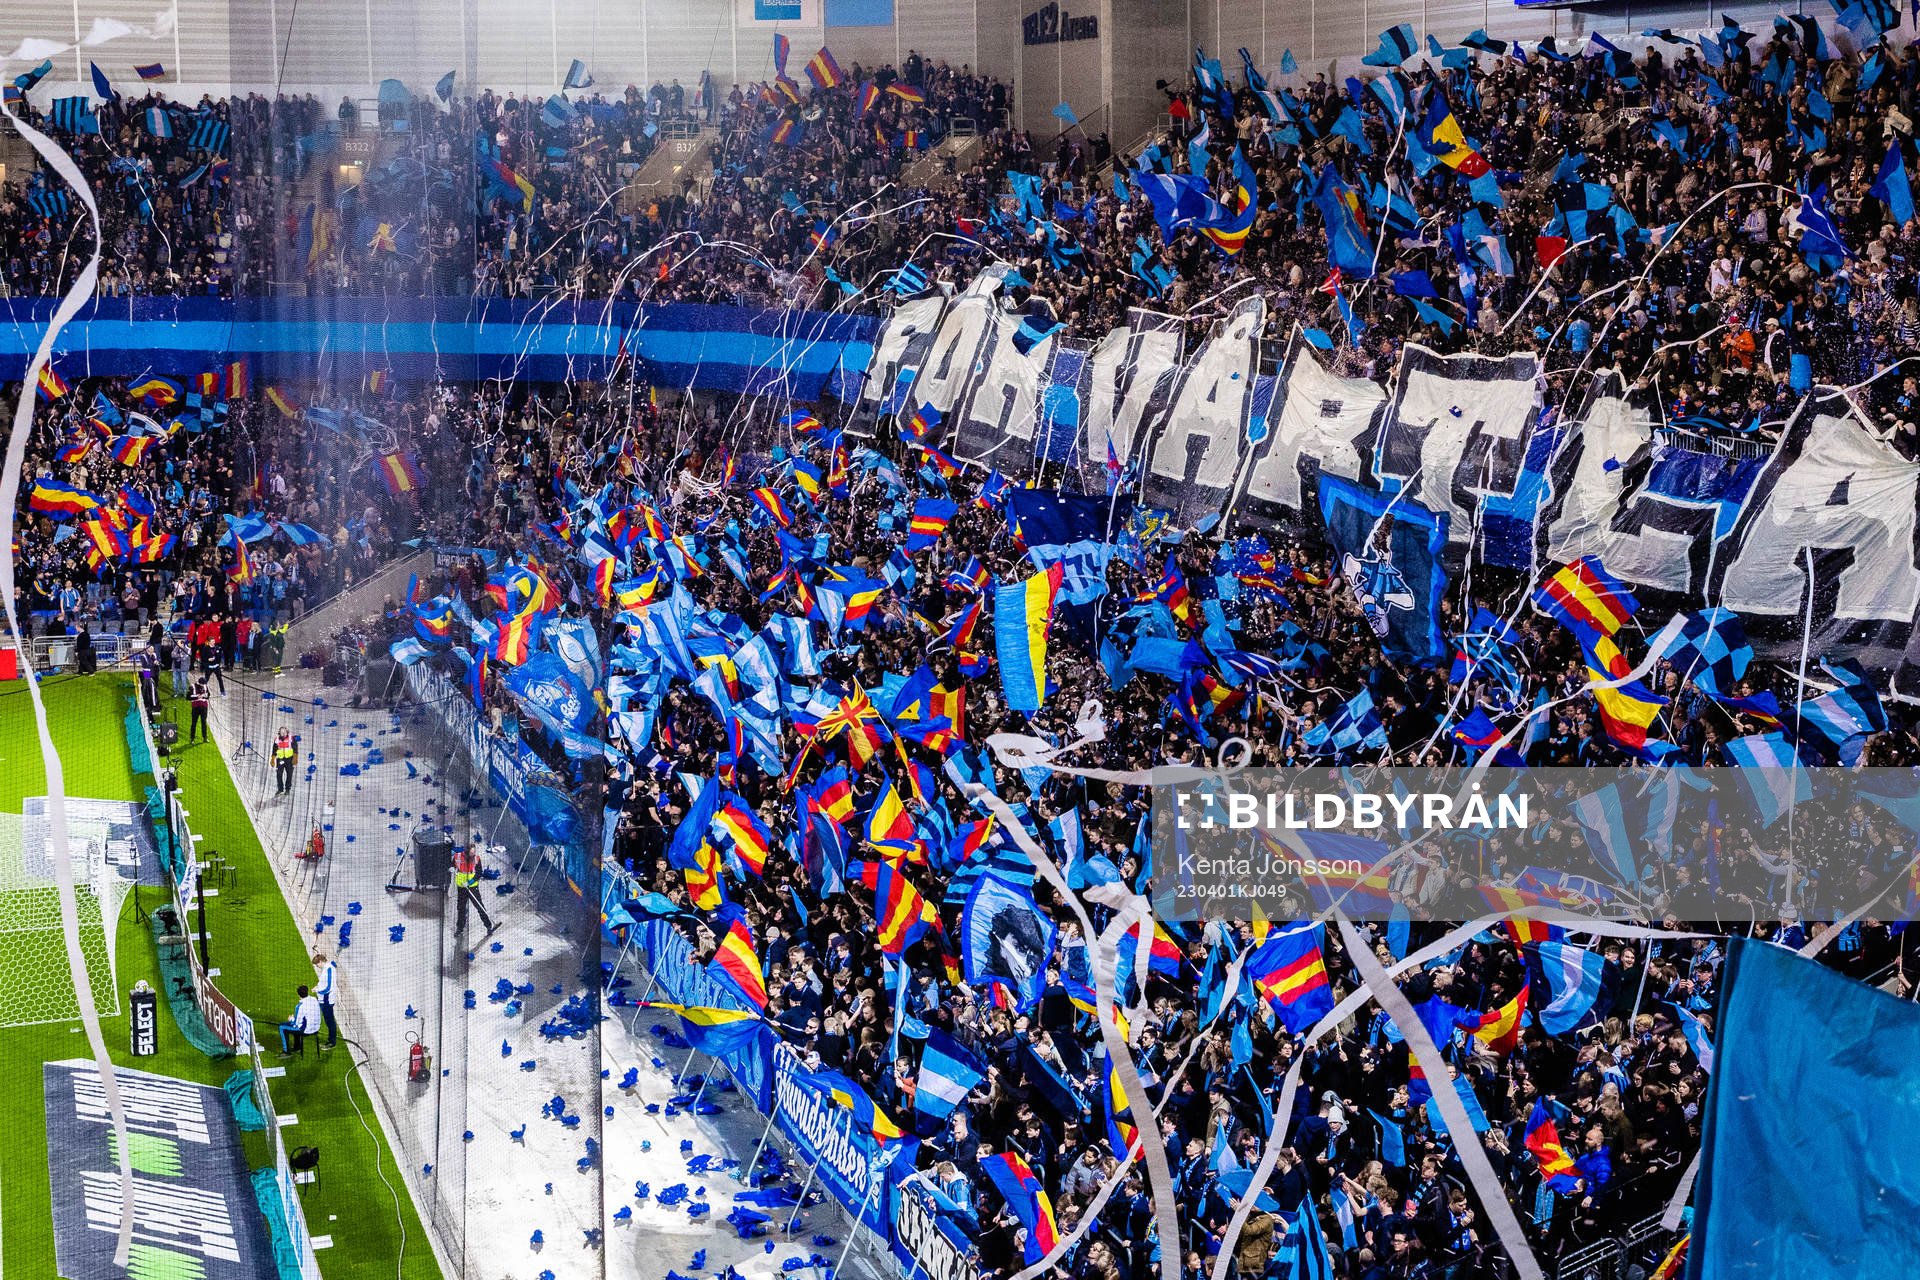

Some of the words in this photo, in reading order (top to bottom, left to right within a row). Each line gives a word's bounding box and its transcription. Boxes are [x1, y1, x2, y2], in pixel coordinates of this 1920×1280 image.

[1059, 11, 1098, 41] Arena
[345, 142, 369, 151] B322
[137, 1003, 154, 1056] SELECT
